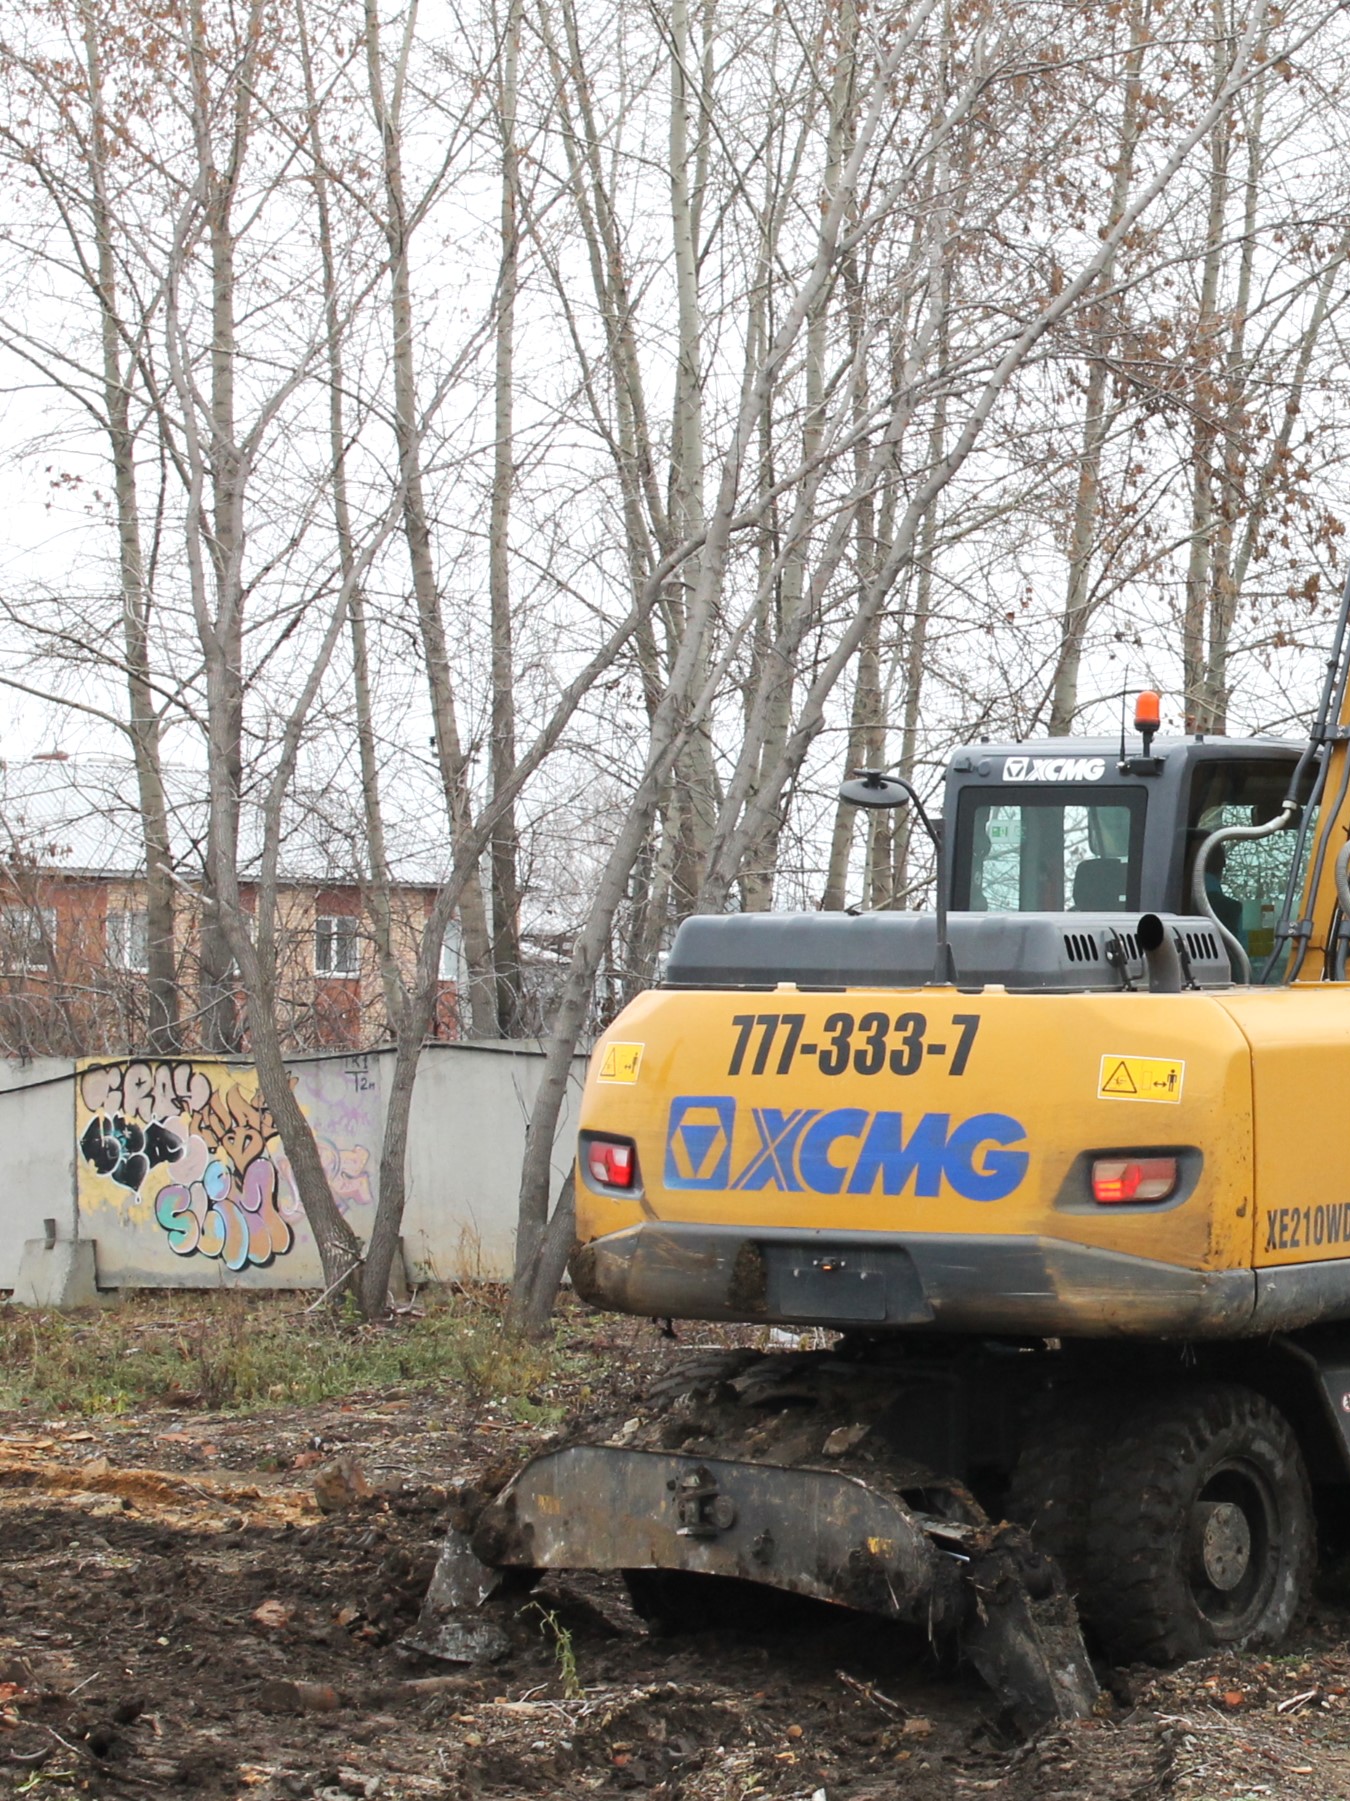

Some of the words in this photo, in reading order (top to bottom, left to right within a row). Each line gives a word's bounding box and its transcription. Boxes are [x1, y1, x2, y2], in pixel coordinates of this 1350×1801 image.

[1024, 758, 1105, 782] XCMG
[727, 1012, 981, 1076] 777-333-7
[727, 1108, 1030, 1202] XCMG
